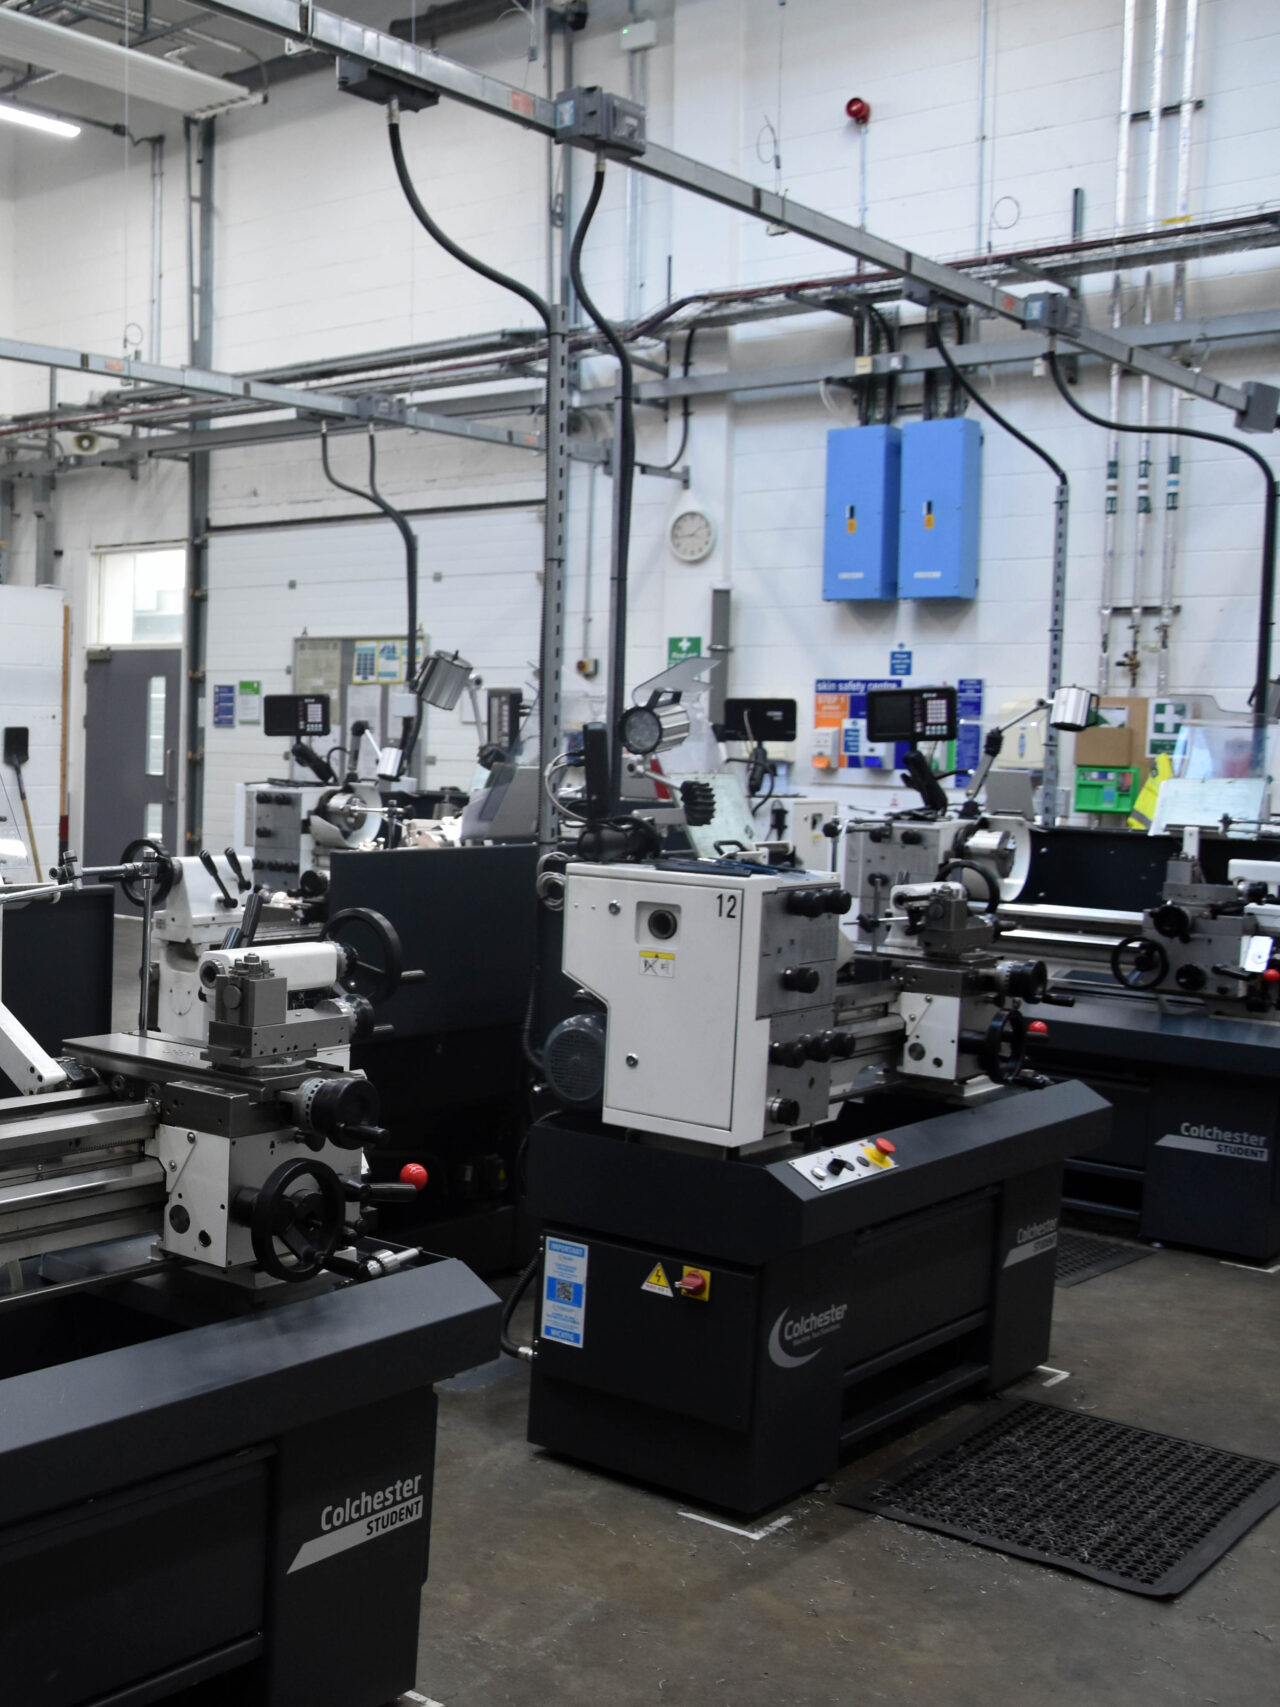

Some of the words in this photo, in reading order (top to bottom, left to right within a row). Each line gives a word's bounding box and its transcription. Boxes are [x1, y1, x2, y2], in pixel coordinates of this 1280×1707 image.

[816, 681, 836, 690] skin
[838, 681, 866, 692] safety
[716, 893, 737, 919] 12
[1180, 1122, 1267, 1146] Colchester
[1216, 1144, 1265, 1158] STUDENT
[784, 1304, 848, 1340] Colchester
[321, 1474, 422, 1531] Colchester
[366, 1500, 420, 1536] STUDENT
